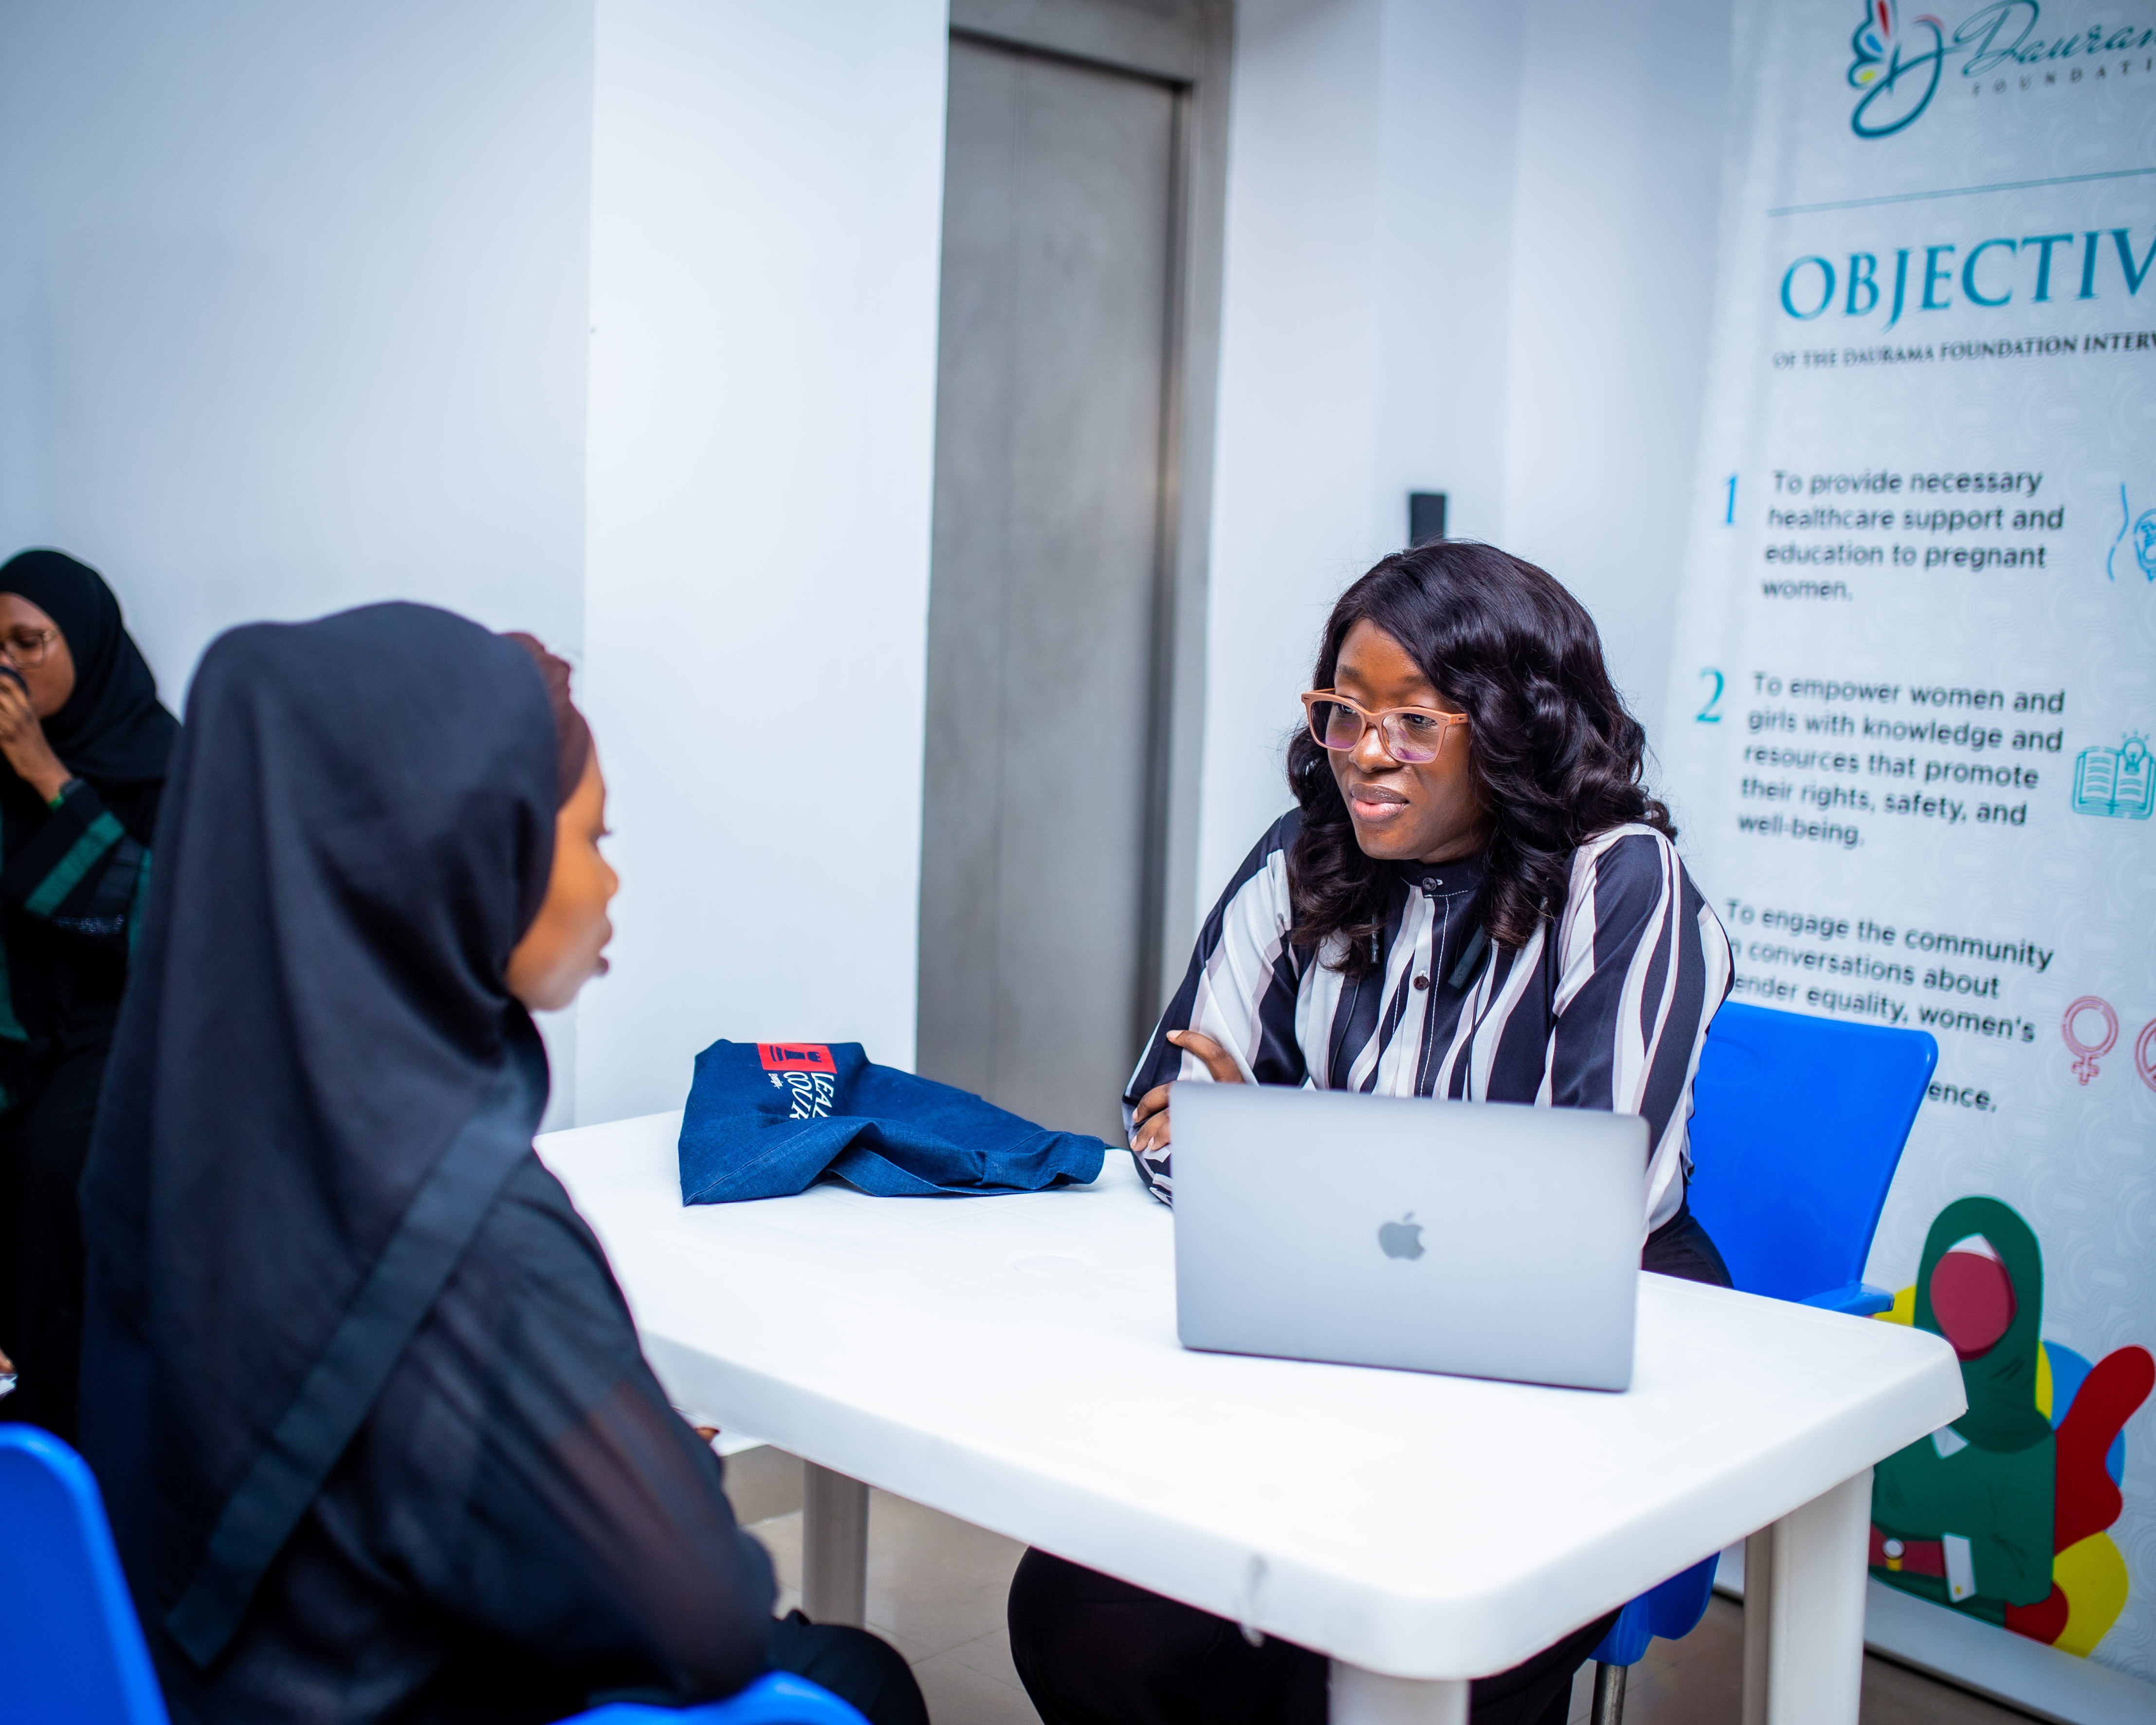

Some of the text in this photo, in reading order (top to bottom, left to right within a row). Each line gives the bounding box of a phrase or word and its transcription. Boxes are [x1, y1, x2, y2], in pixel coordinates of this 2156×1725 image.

[1843, 344, 1935, 366] DAURAMA
[1940, 334, 2079, 360] FOUNDATION
[1723, 472, 1739, 527] 1
[1772, 469, 2045, 498] To provide necessary
[1768, 504, 2065, 535] healthcare support and
[1764, 540, 2048, 573] education to pregnant
[1762, 580, 1853, 601] women.
[1695, 667, 1725, 724] 2
[1753, 671, 2066, 715] To empower women and
[1748, 708, 2064, 753] girls with knowledge and
[1744, 745, 2040, 790] resources that promote
[1741, 776, 2028, 826] their rights, safety, and
[1737, 814, 1864, 850] well-being.
[1725, 898, 2055, 973] To engage the community
[1729, 938, 2001, 1000] n conversations about
[1734, 974, 2036, 1042] ender equality, women's
